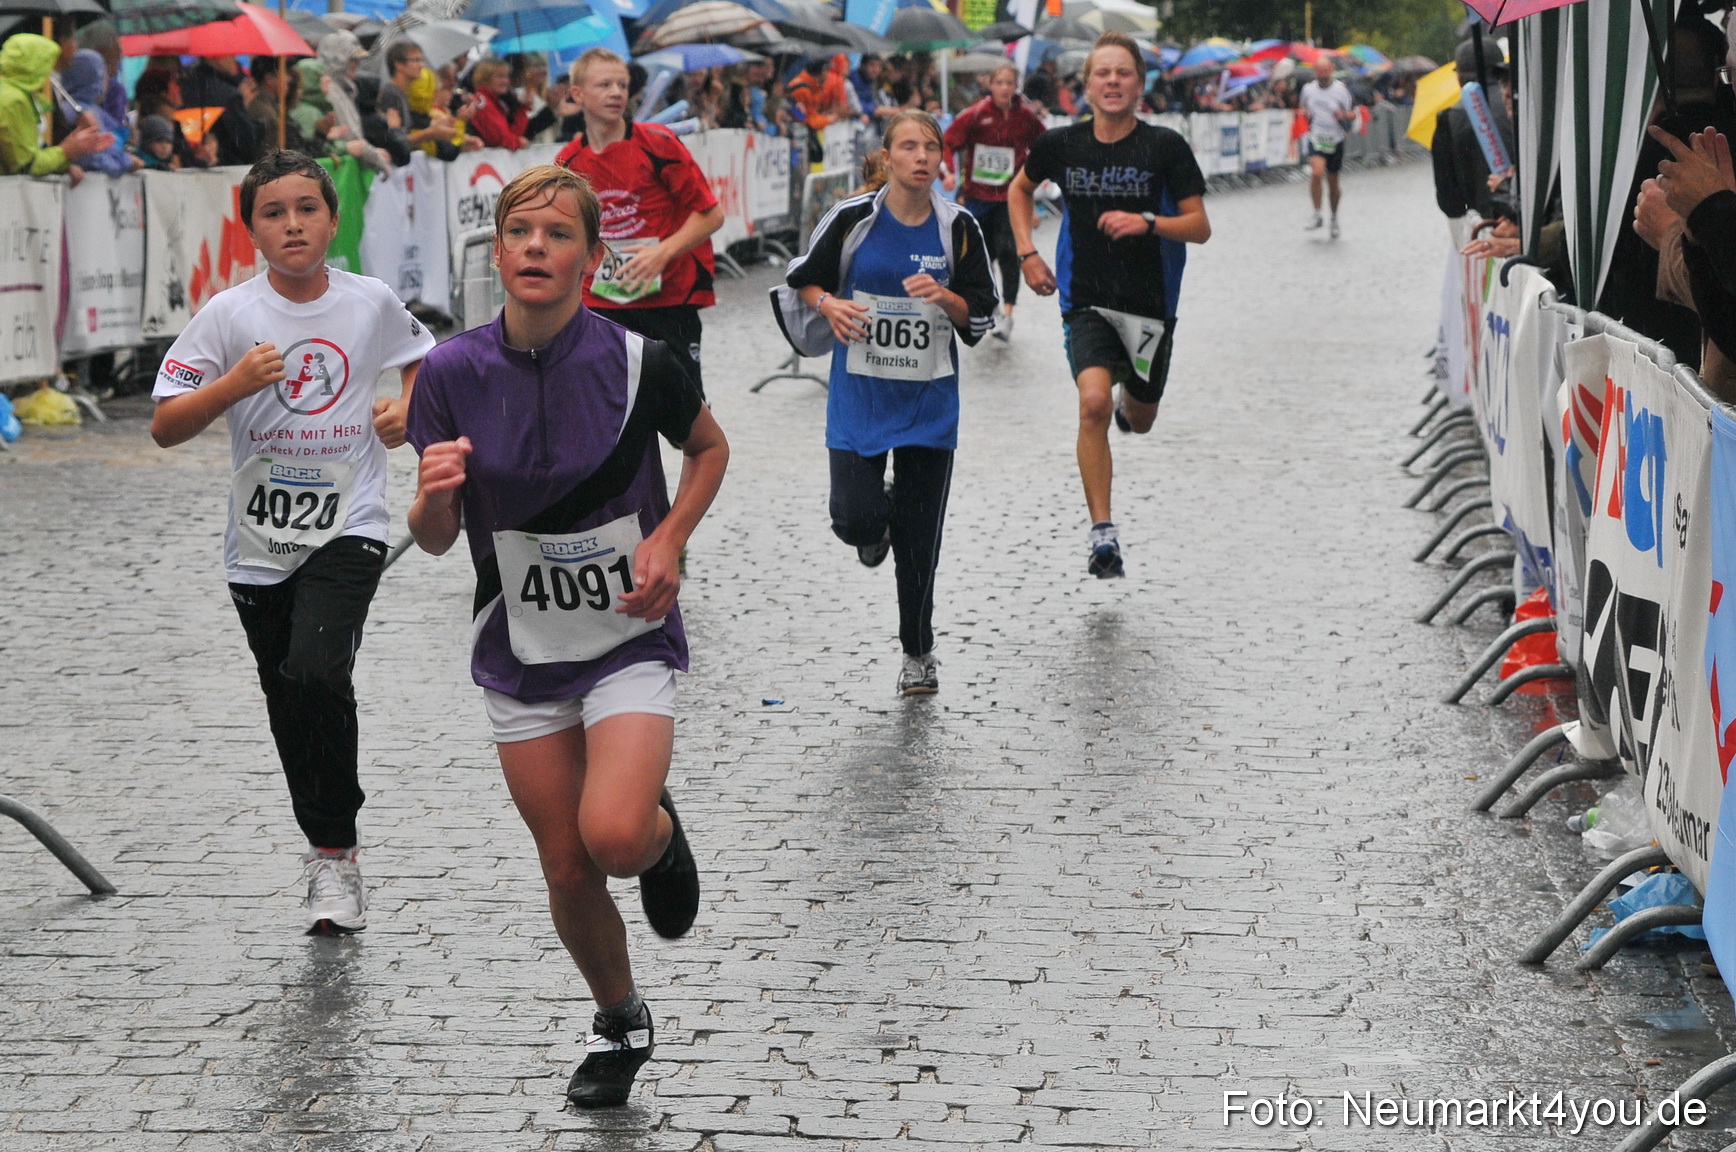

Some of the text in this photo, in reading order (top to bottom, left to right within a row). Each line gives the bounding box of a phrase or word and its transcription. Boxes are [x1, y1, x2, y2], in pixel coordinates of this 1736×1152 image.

[865, 351, 919, 368] Franziska
[301, 429, 326, 440] MIT
[333, 424, 362, 438] HERZ
[270, 445, 293, 455] Heck
[321, 443, 351, 455] Röschl
[270, 464, 321, 479] BOCK
[246, 484, 340, 530] 4020
[540, 537, 598, 555] BOCK
[520, 554, 634, 611] 4091
